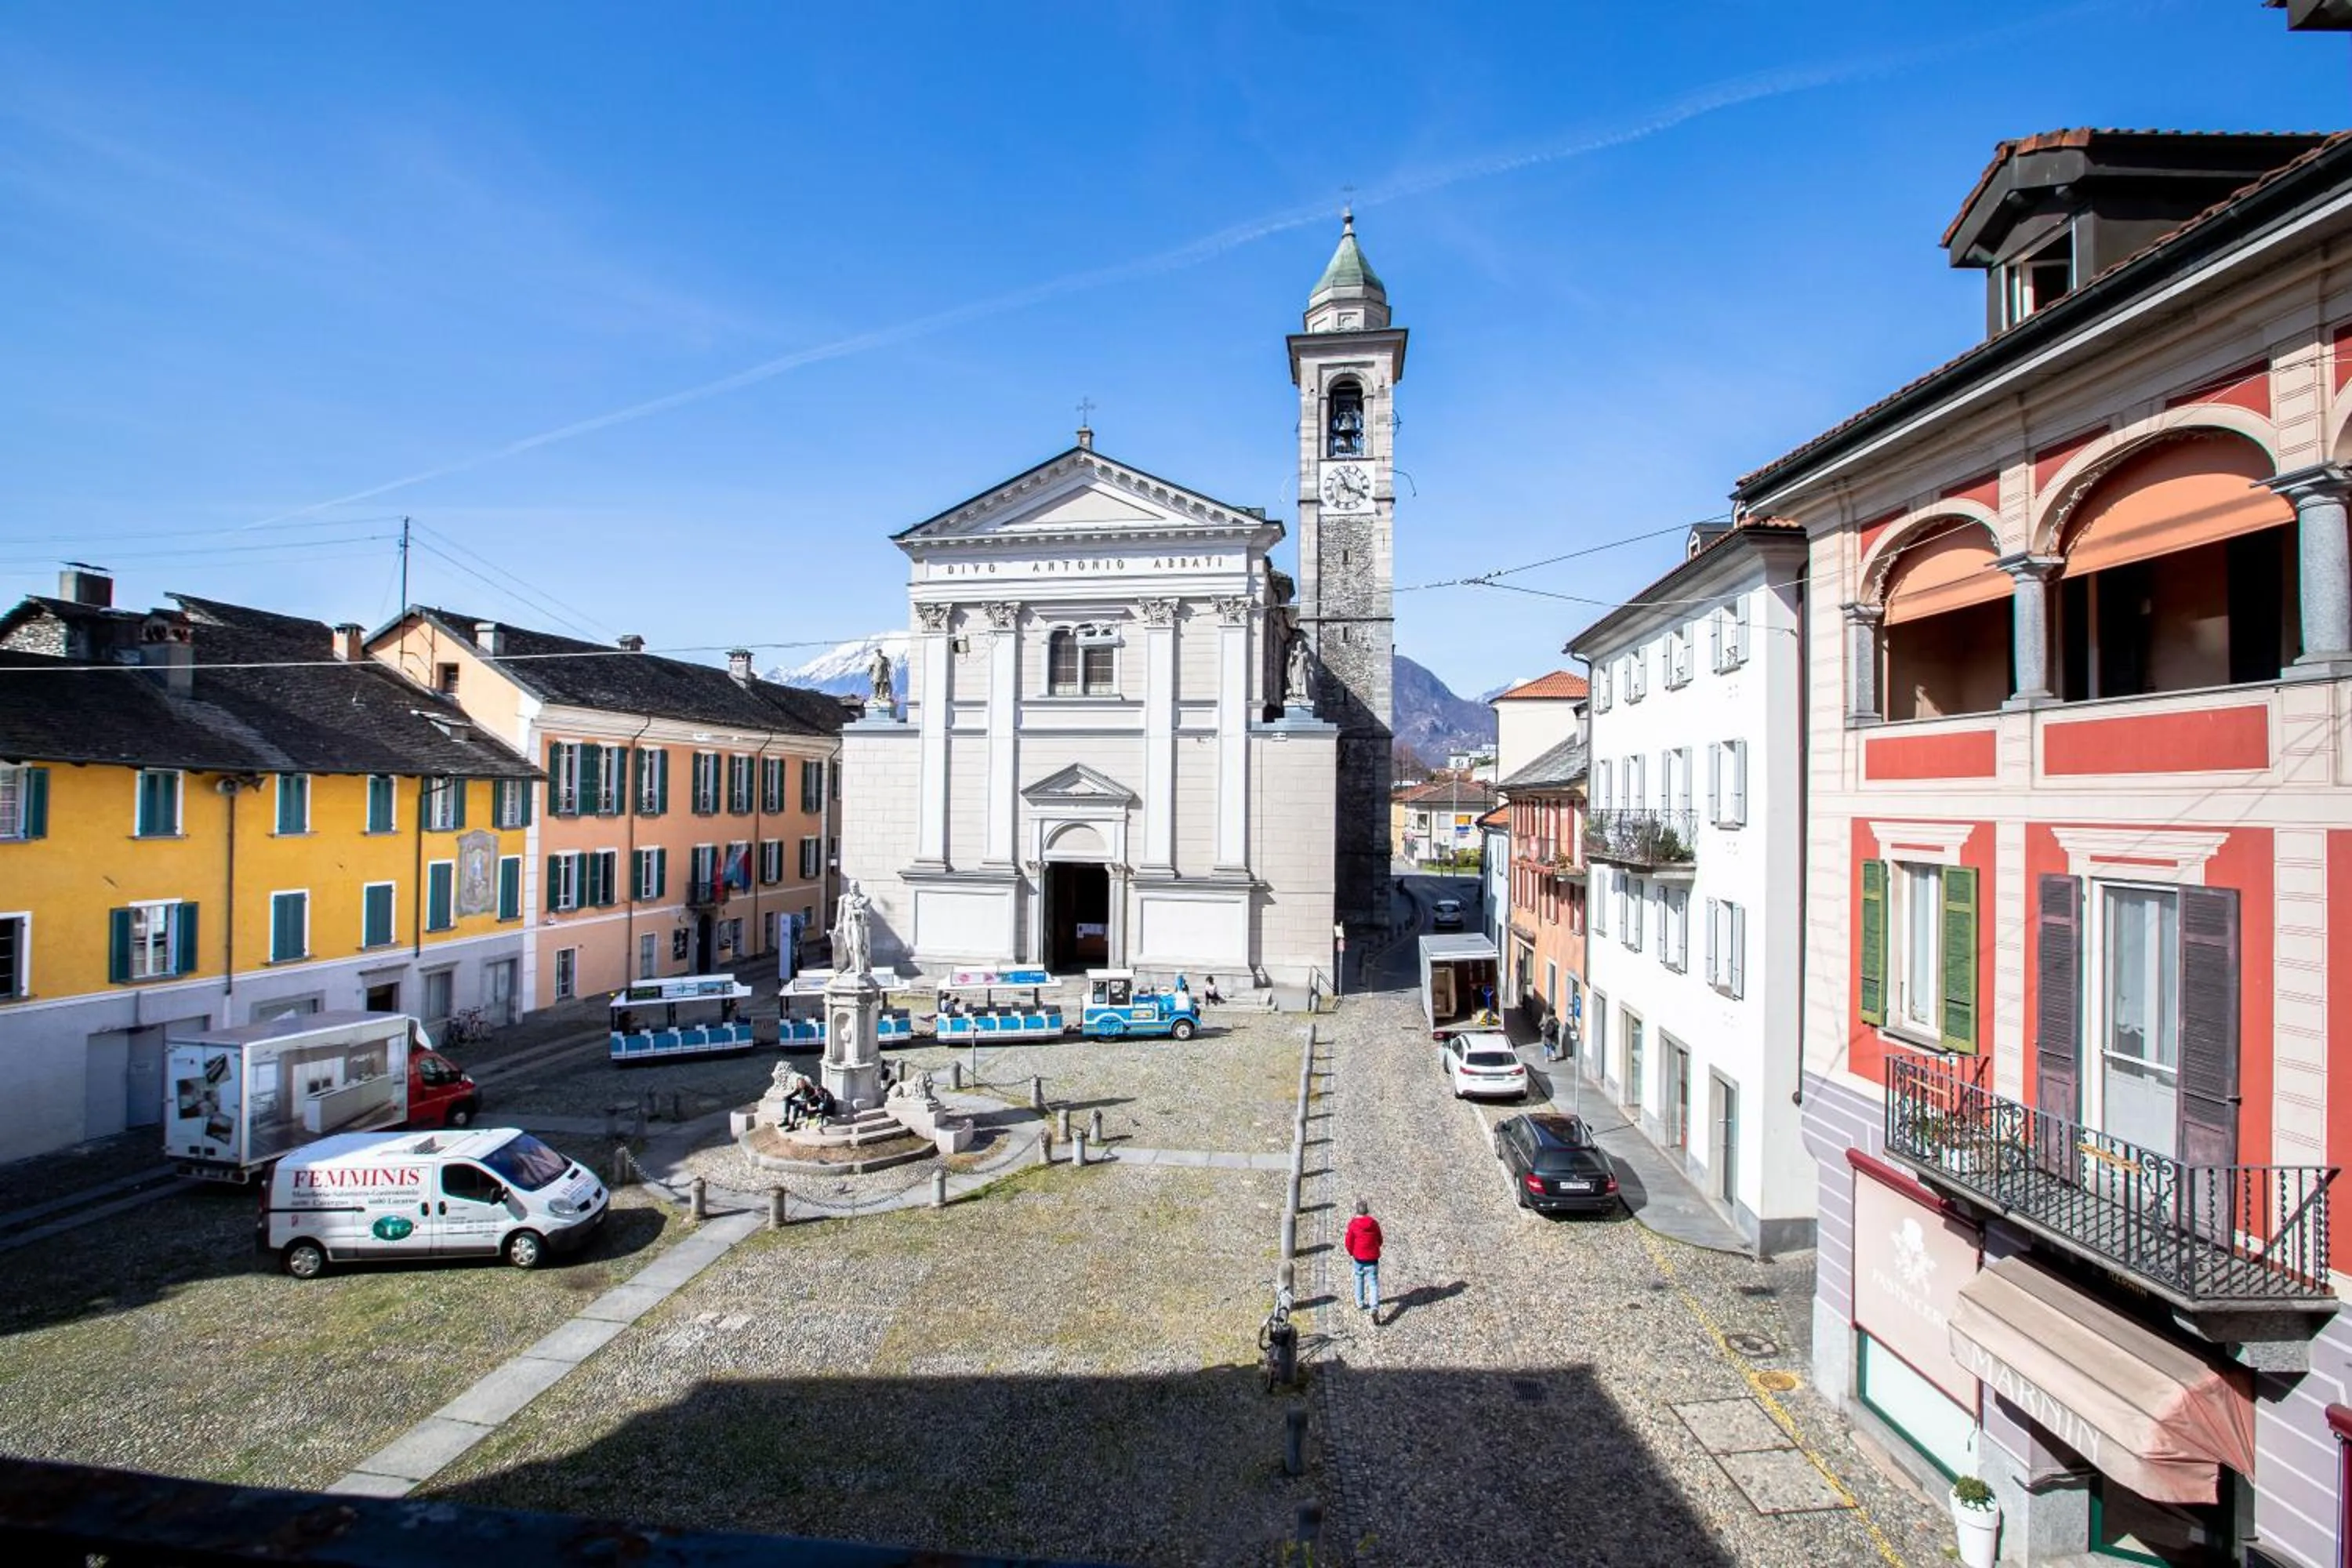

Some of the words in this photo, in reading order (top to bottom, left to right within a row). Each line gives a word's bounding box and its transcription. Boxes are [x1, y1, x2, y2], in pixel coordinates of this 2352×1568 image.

[948, 564, 995, 574] DIVO
[1033, 559, 1124, 572] ANTONIO
[1154, 557, 1222, 568] ABBATI
[293, 1169, 419, 1188] FEMMINIS
[1971, 1342, 2100, 1463] MARNIN
